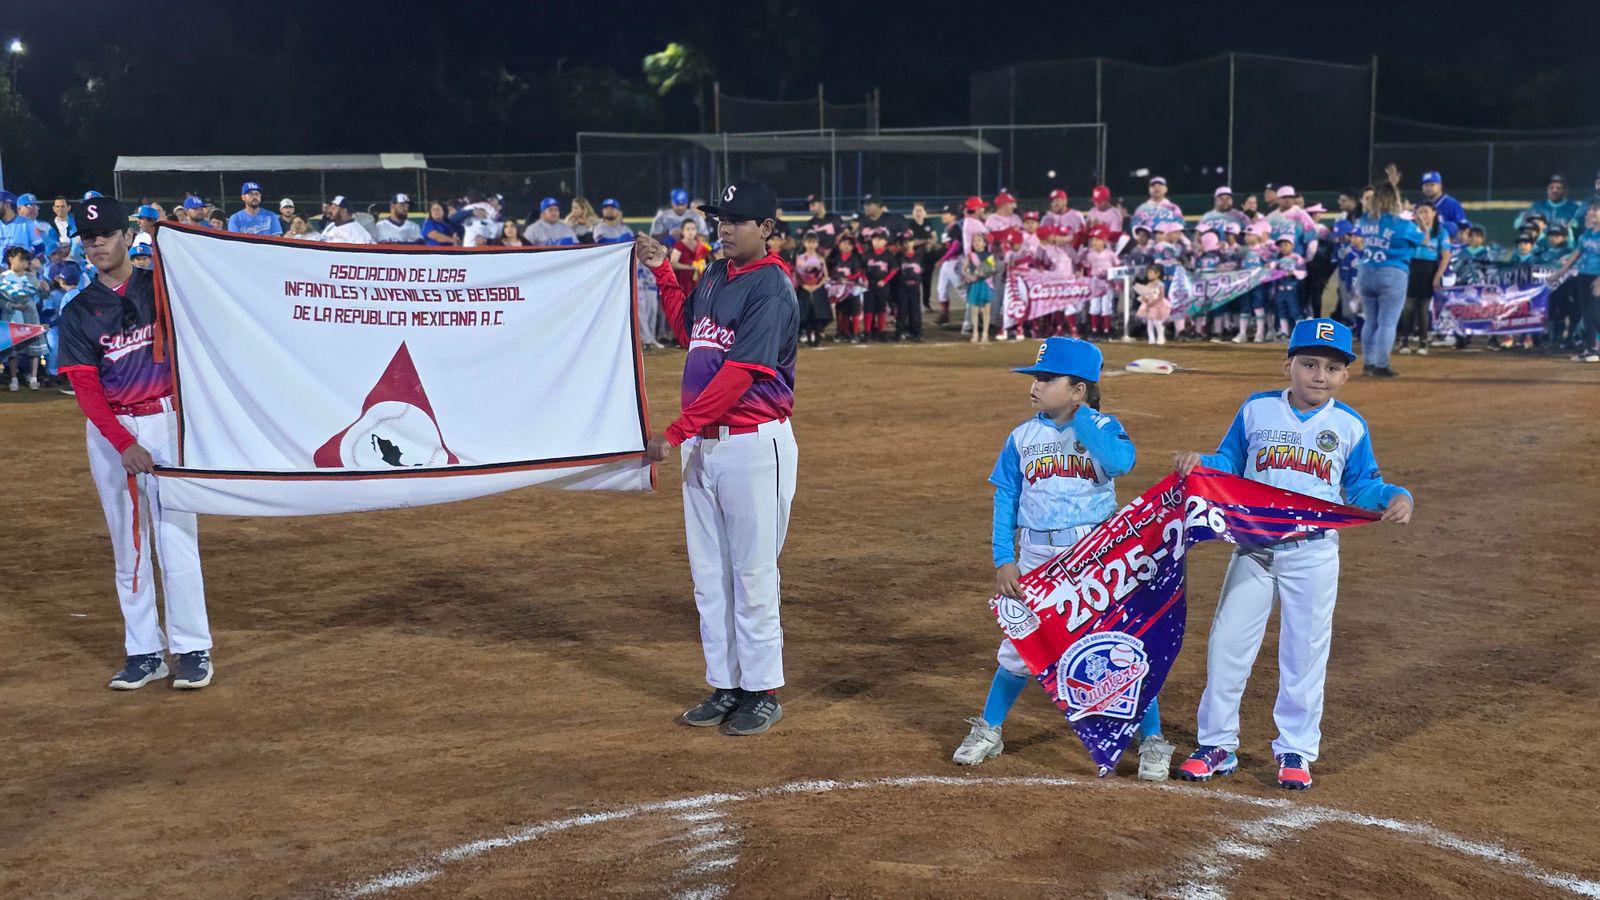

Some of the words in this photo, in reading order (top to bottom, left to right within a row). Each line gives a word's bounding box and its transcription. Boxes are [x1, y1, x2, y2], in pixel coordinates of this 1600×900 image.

[724, 185, 737, 202] S
[87, 204, 99, 220] S
[329, 264, 406, 282] ASOCIACION
[409, 268, 425, 283] DE
[428, 268, 467, 283] LIGAS
[284, 281, 358, 300] INFANTILES
[360, 286, 368, 301] Y
[371, 287, 442, 302] JUVENILES
[446, 289, 463, 303] DE
[468, 286, 525, 302] BEISBOL
[293, 305, 311, 322] DE
[314, 306, 331, 323] LA
[334, 308, 407, 326] REPUBLICA
[411, 311, 477, 326] MEXICANA
[1025, 454, 1100, 486] CATALINA
[1255, 445, 1333, 486] CATALINA
[1045, 513, 1157, 584] Temporada
[1160, 486, 1183, 507] 46
[1113, 633, 1142, 649] MUNICIPAL
[1076, 662, 1141, 705] Quintero
